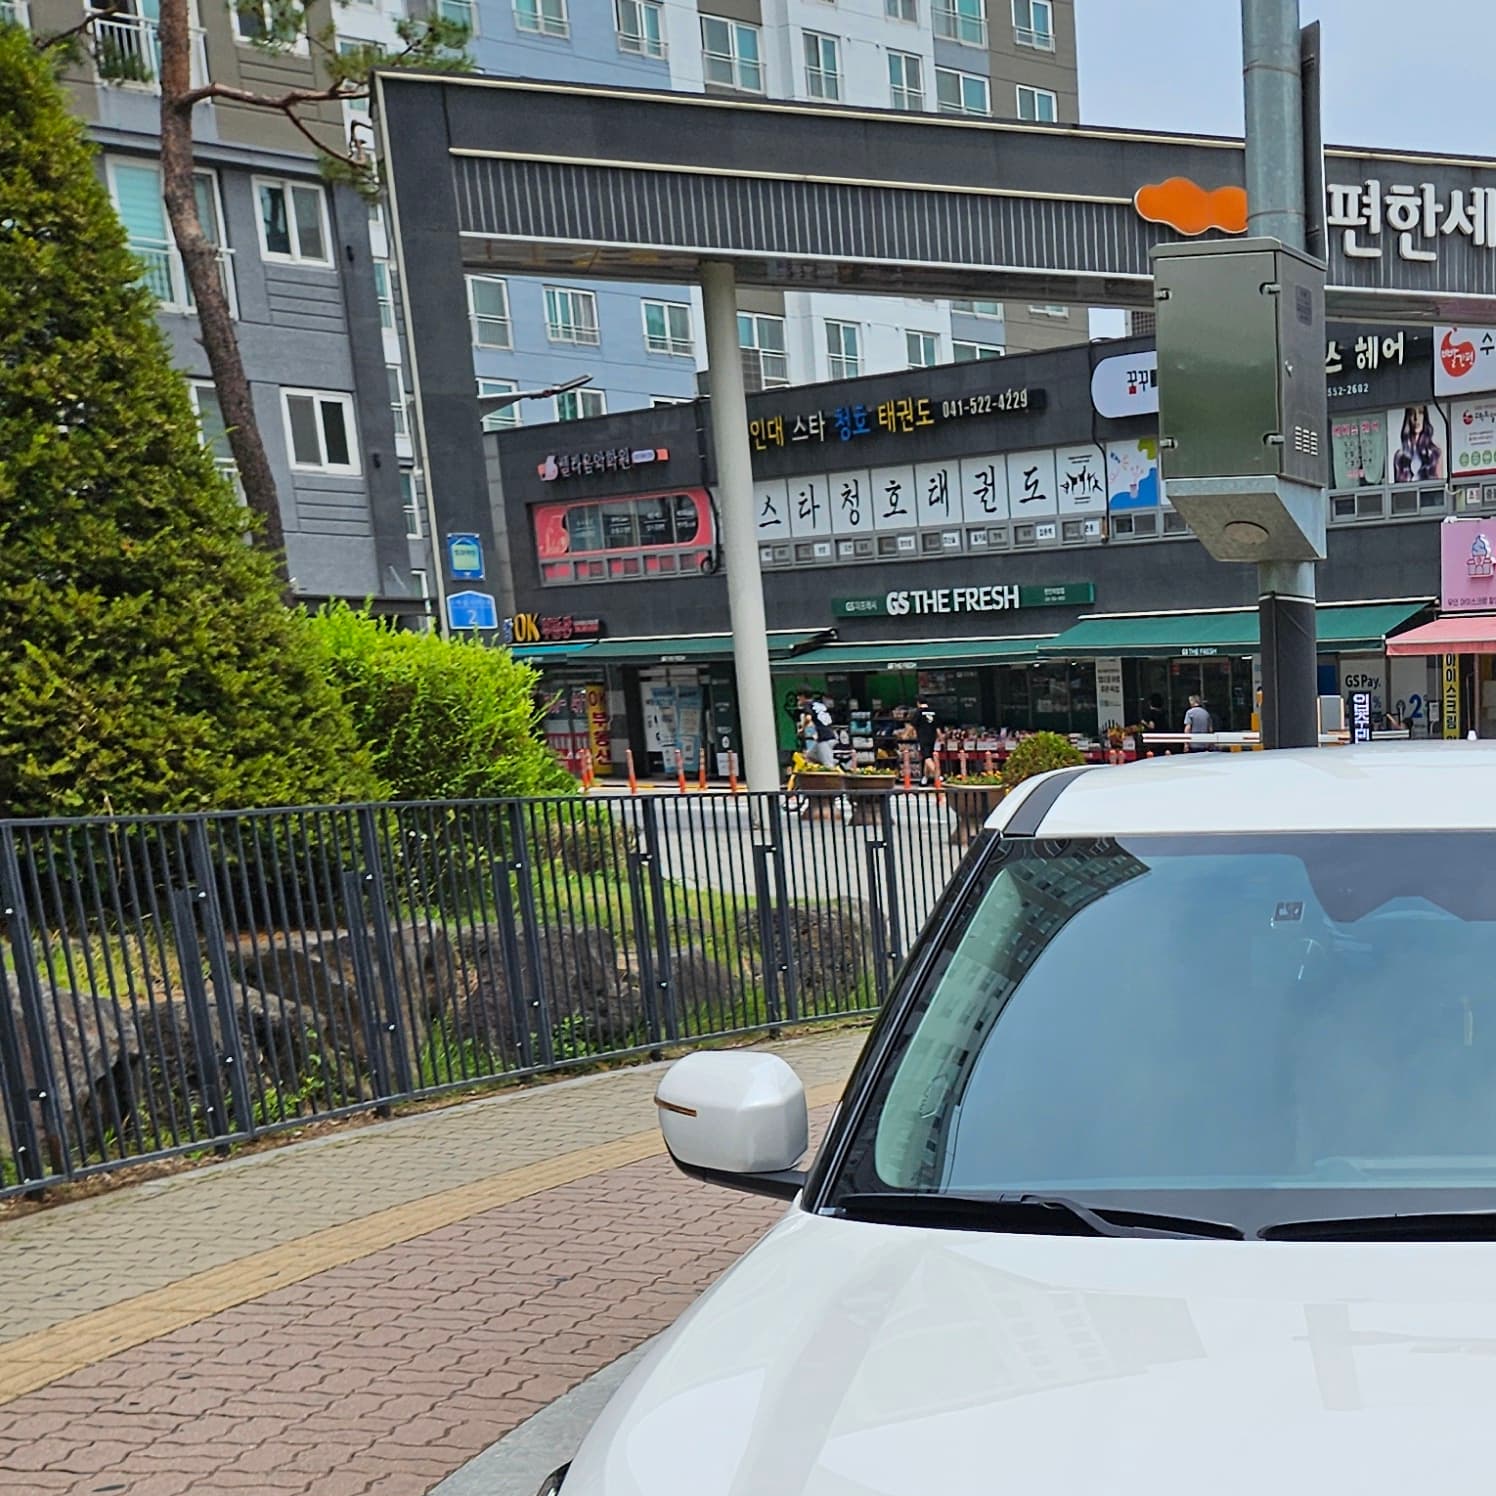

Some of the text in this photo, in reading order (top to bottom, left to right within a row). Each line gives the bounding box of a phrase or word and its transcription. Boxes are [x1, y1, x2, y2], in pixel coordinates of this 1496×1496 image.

[1355, 331, 1404, 369] 헤어
[792, 410, 825, 441] 스타
[834, 405, 871, 441] 청호
[878, 396, 934, 432] 태권도
[886, 591, 910, 615] GS
[911, 589, 951, 614] THE
[953, 585, 1019, 612] FRESH
[514, 613, 540, 641] OK
[1345, 674, 1359, 688] GS
